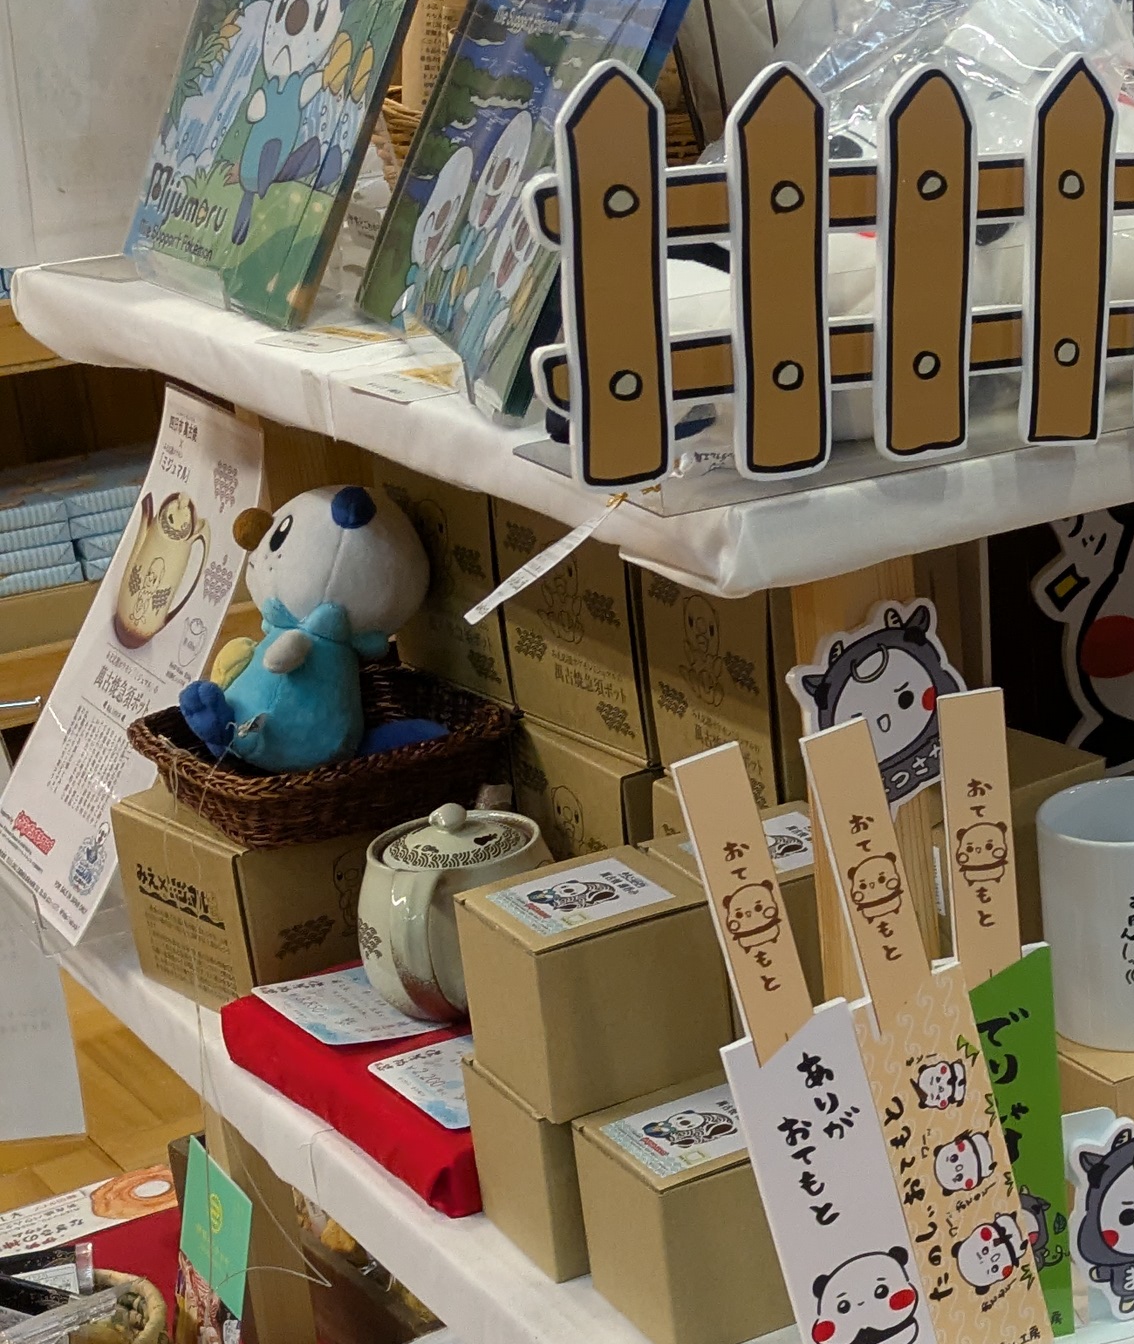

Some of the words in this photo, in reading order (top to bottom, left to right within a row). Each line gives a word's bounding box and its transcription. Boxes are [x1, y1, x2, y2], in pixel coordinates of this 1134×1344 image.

[797, 1053, 861, 1140] ありが
[777, 1117, 841, 1226] おてもと
